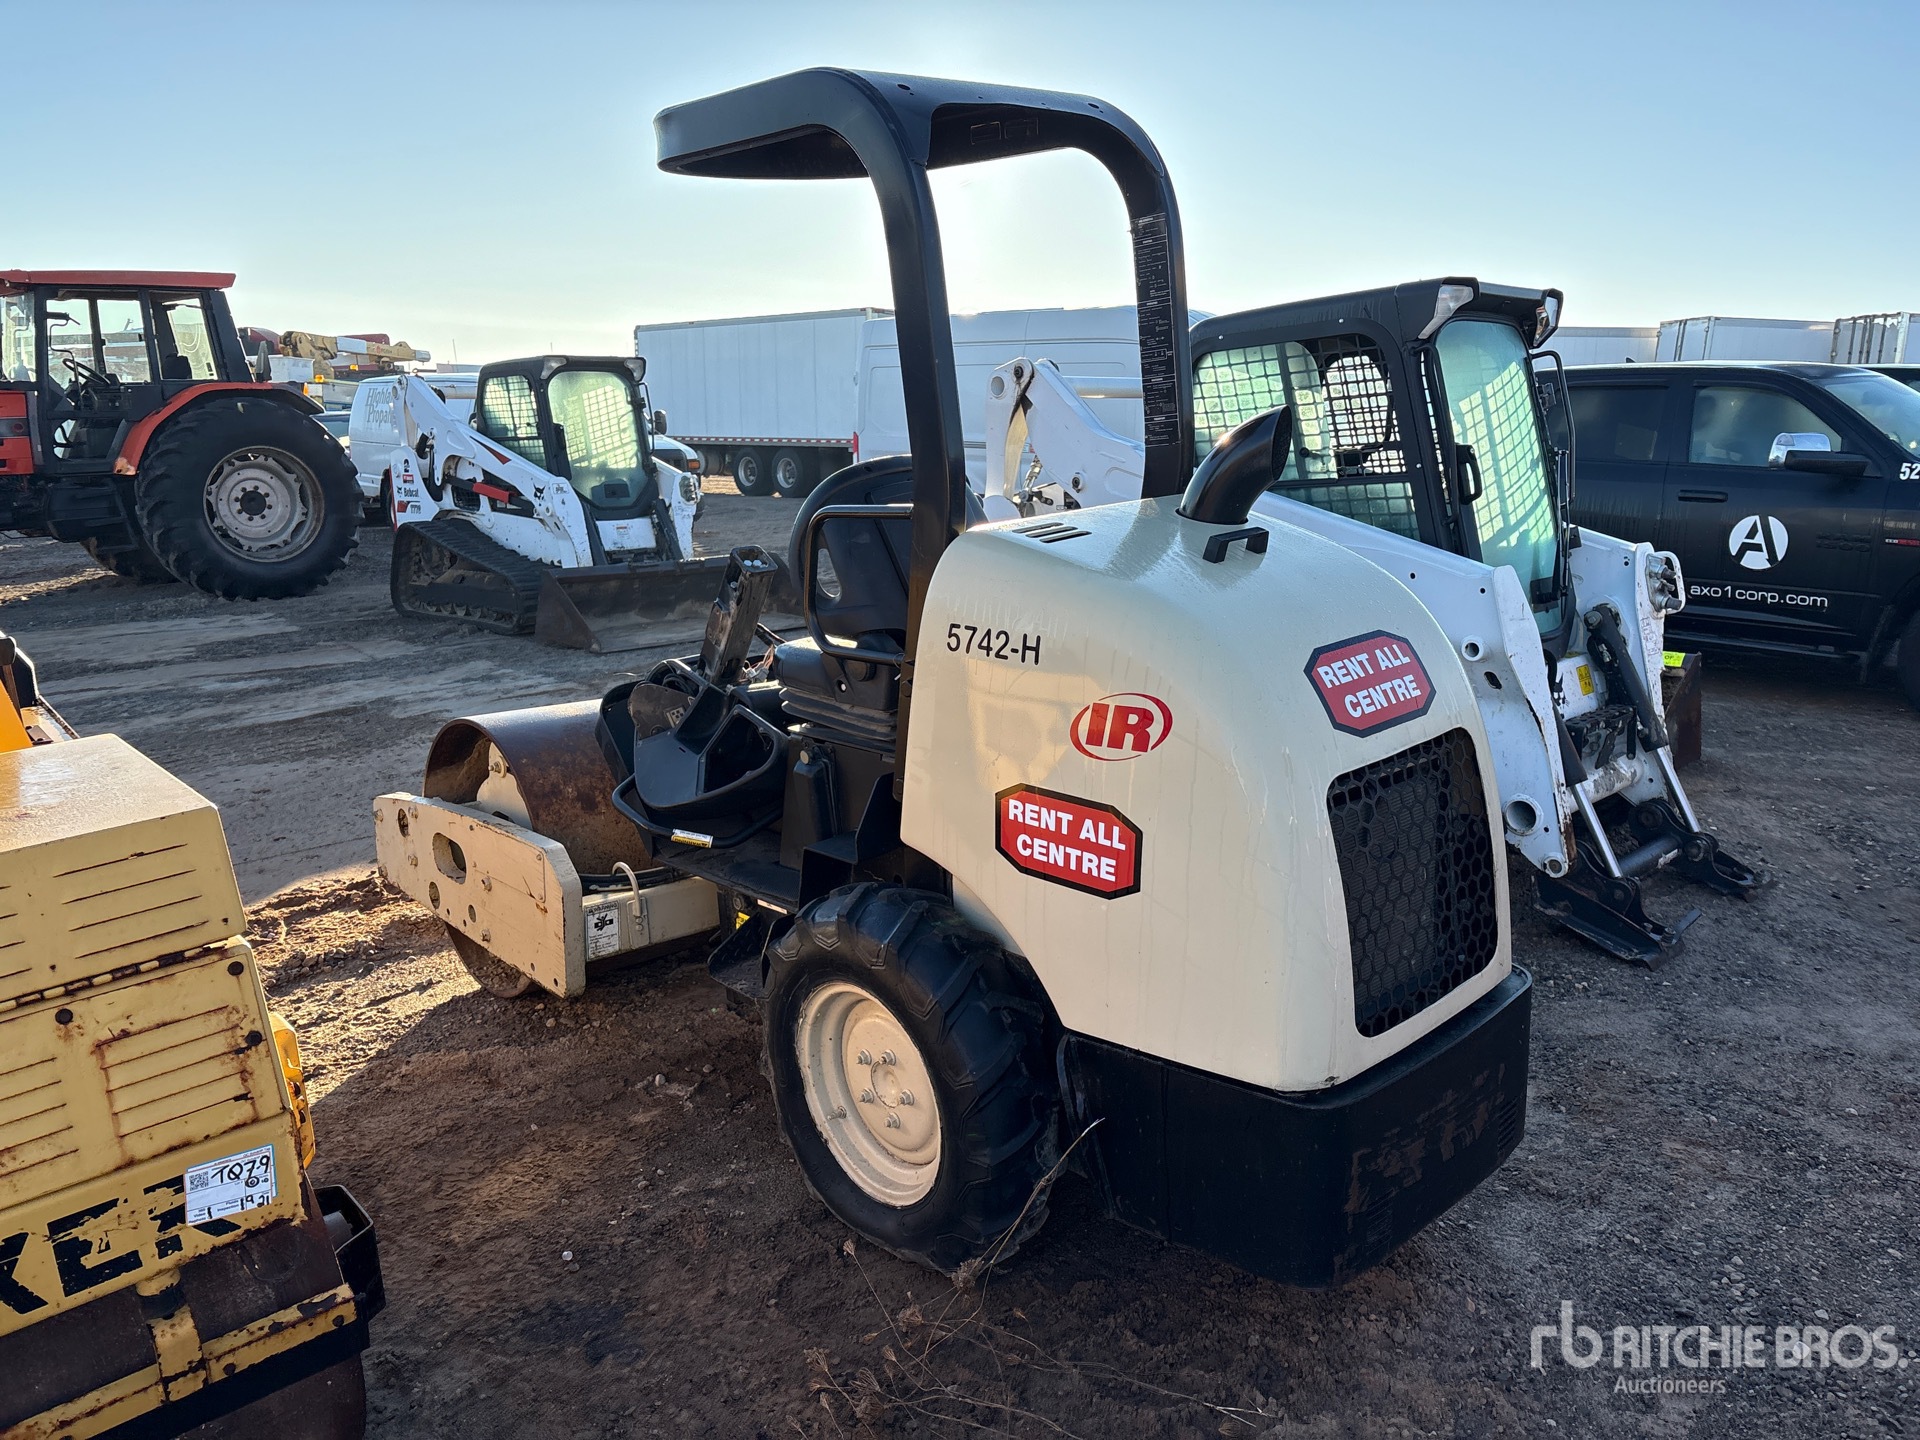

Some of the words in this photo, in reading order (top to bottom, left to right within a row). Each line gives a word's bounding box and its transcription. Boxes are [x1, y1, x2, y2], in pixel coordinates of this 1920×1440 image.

[1690, 585, 1829, 608] axo1corp.com
[946, 623, 1041, 666] 5742-H
[1317, 653, 1374, 689] RENT
[1375, 644, 1411, 671] ALL
[1344, 674, 1422, 718] CENTRE
[1085, 702, 1155, 753] IR
[1008, 798, 1073, 835] RENT
[1079, 818, 1126, 851] ALL
[1016, 833, 1117, 882] CENTRE
